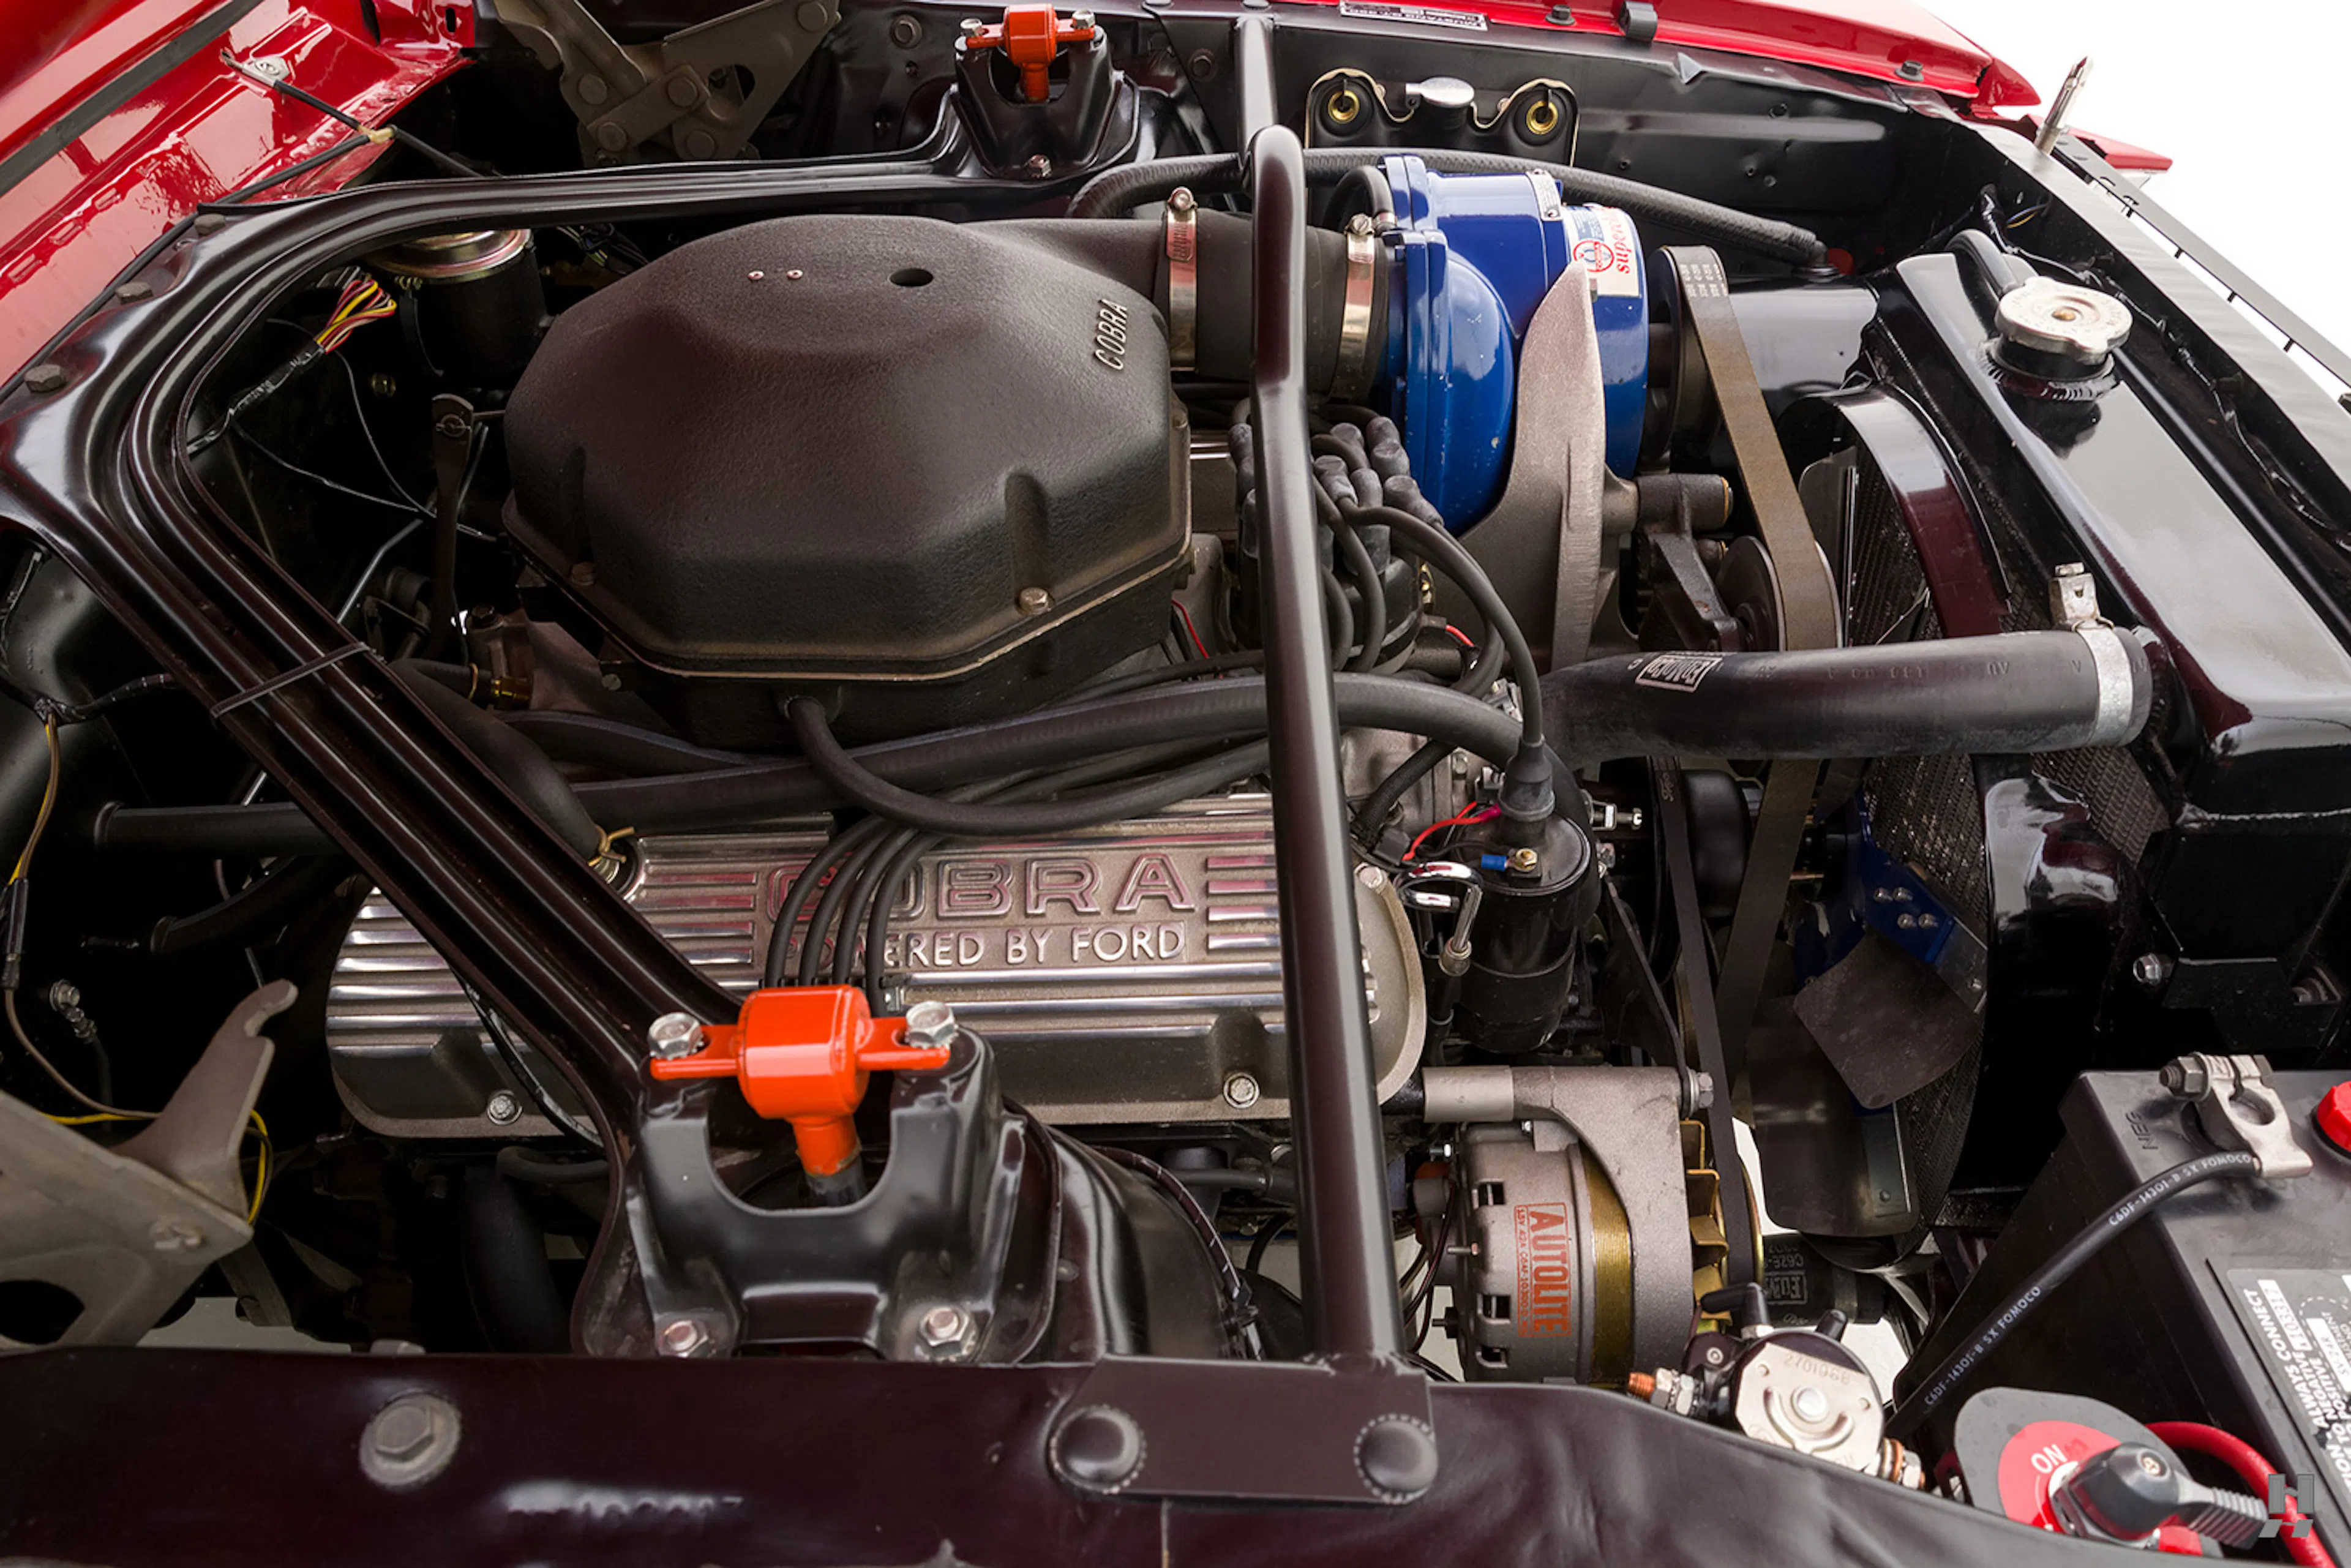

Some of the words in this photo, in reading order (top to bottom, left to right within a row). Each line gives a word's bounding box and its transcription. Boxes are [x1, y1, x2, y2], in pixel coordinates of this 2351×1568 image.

[1095, 299, 1128, 370] COBRA
[1007, 928, 1053, 965] BY
[1071, 925, 1186, 963] FORD
[2125, 1111, 2159, 1150] NEG
[1529, 1210, 1569, 1332] AUTOLITE
[1997, 1286, 2041, 1329] FOMOCO
[2243, 1289, 2292, 1362] CONNECT
[2284, 1364, 2330, 1428] ALWAYS
[2292, 1351, 2338, 1420] NEGATIVE
[2308, 1357, 2351, 1419] POSITIVE
[2031, 1444, 2068, 1474] ON
